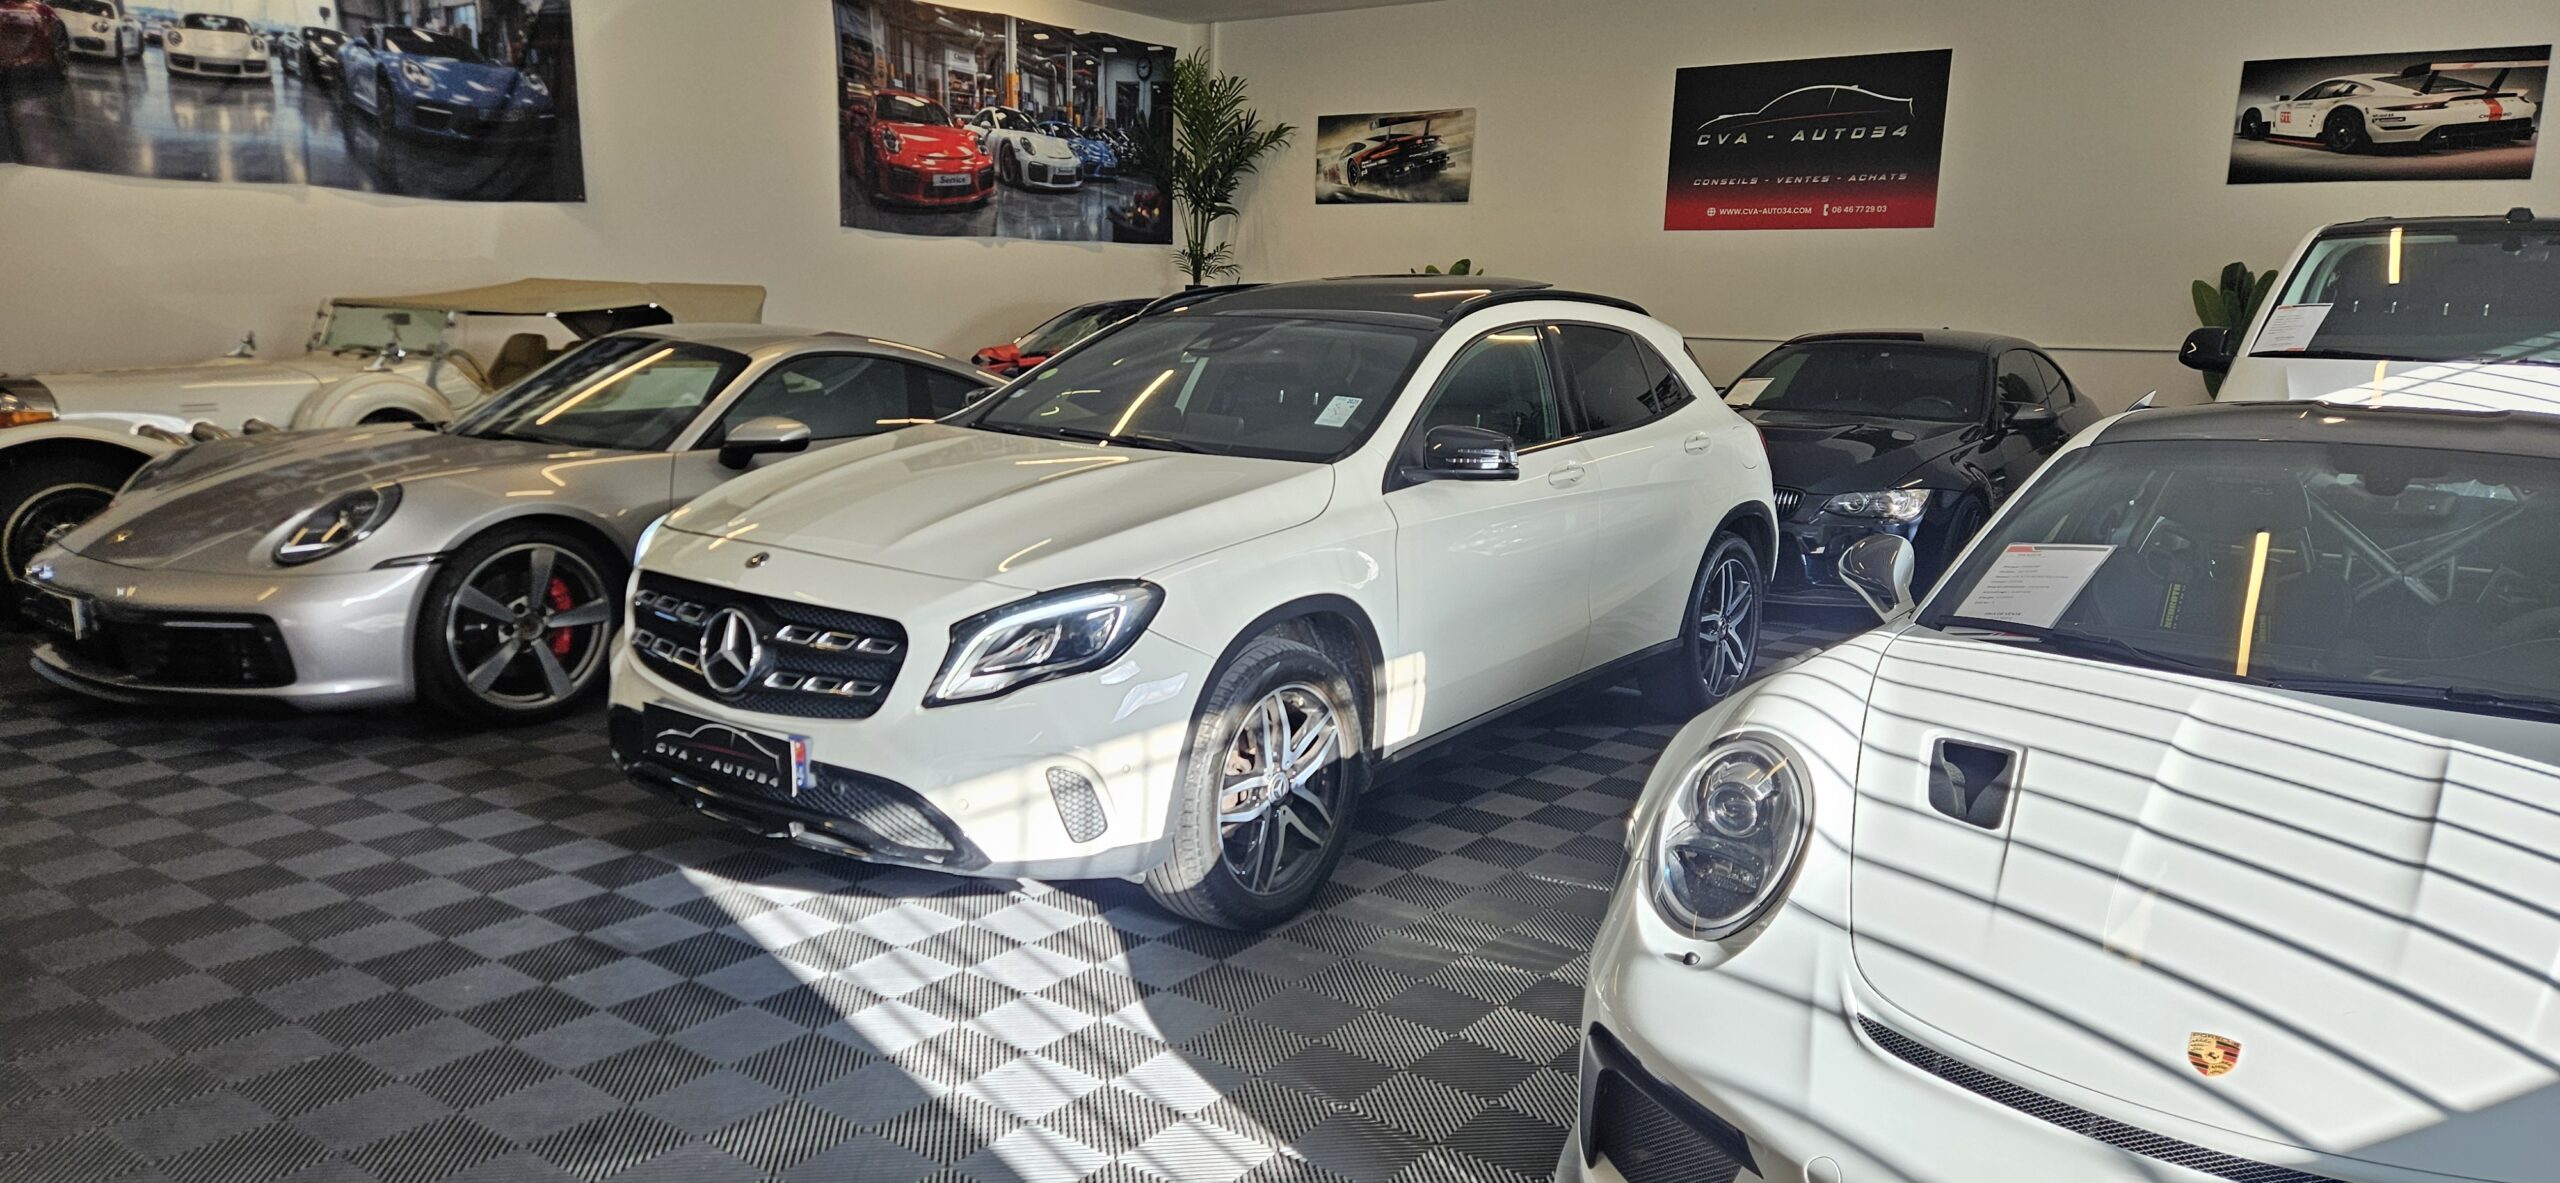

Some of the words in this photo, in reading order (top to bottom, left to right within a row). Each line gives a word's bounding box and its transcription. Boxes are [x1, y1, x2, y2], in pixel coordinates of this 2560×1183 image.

[1696, 132, 1749, 146] CVA
[1791, 125, 1909, 143] AUTO34
[1693, 177, 1759, 187] CONSEILS
[1776, 175, 1831, 185] VENTES
[1848, 173, 1908, 182] ACHATS
[1719, 206, 1812, 216] WWW.CVA-AUTO34.COM
[1831, 206, 1842, 214] 06
[1876, 205, 1888, 213] 03
[655, 742, 688, 761] CVA
